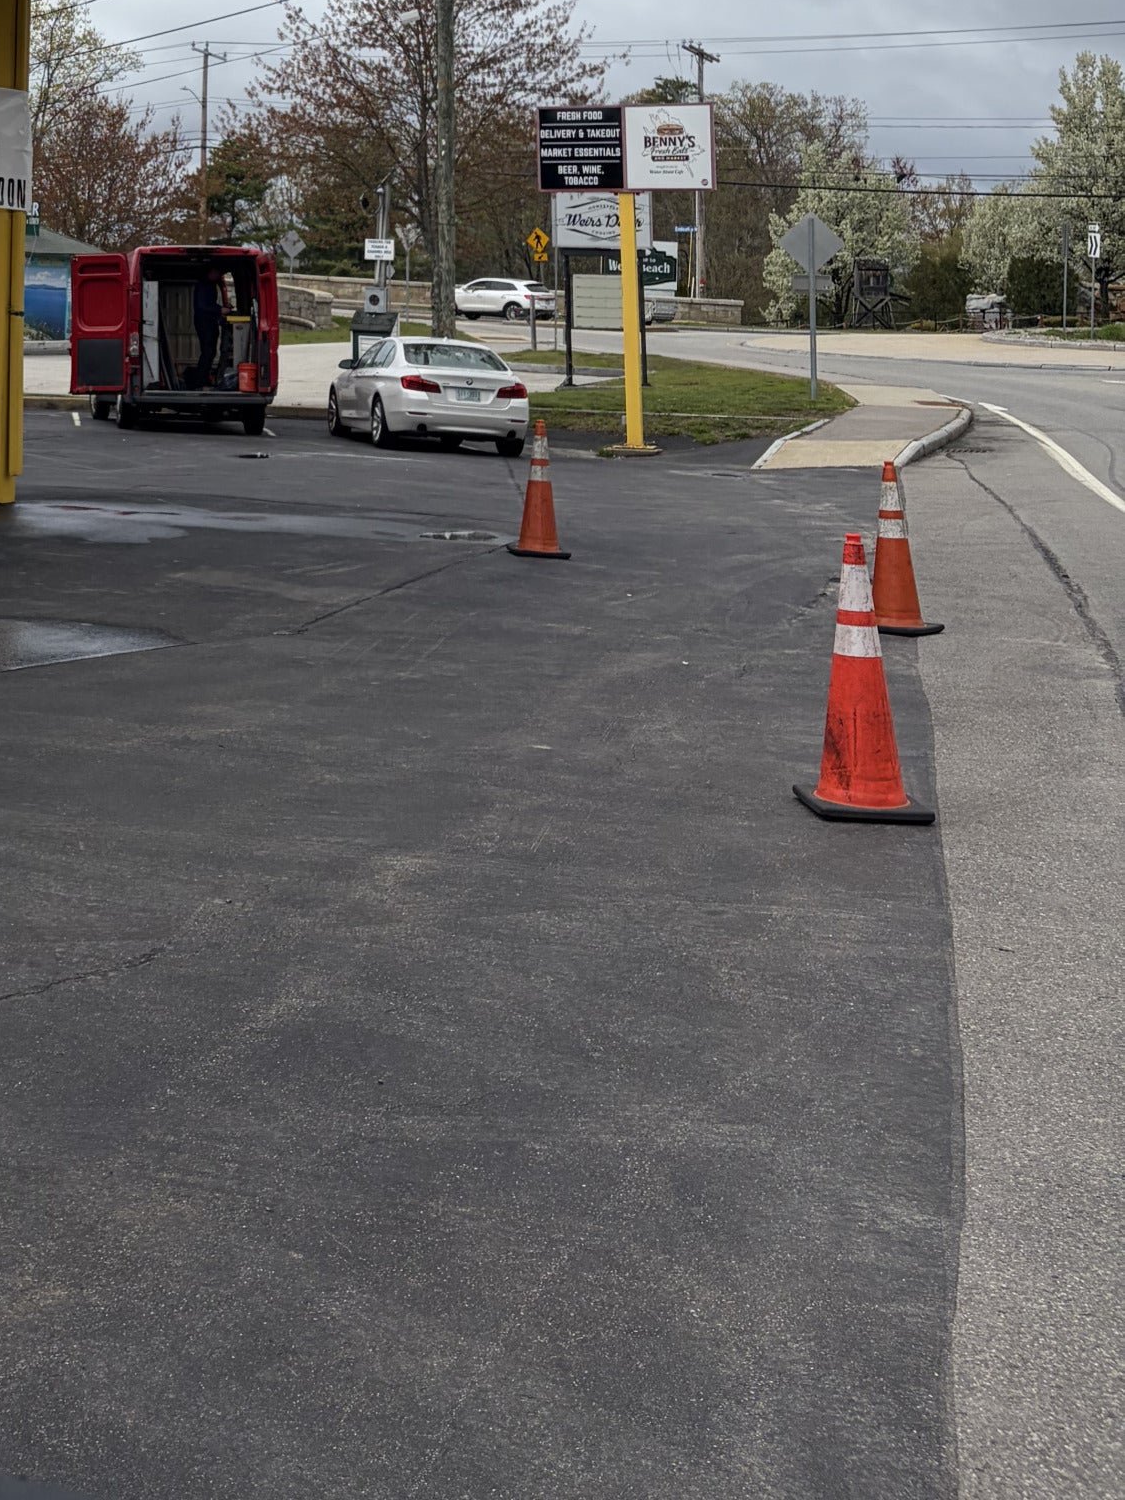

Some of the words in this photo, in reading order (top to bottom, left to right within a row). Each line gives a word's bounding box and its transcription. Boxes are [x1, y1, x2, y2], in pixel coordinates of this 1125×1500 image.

[556, 111, 581, 121] FRESH
[582, 110, 603, 120] FOOD
[540, 129, 576, 139] DELIVERY
[578, 129, 584, 138] &
[586, 128, 620, 138] TAKEOUT
[644, 134, 696, 149] BENNY'S
[540, 147, 572, 157] MARKET
[574, 147, 621, 157] ESSENTIALS
[557, 165, 580, 175] BEER,
[564, 176, 598, 186] TOBACCO
[565, 213, 602, 227] Weirs
